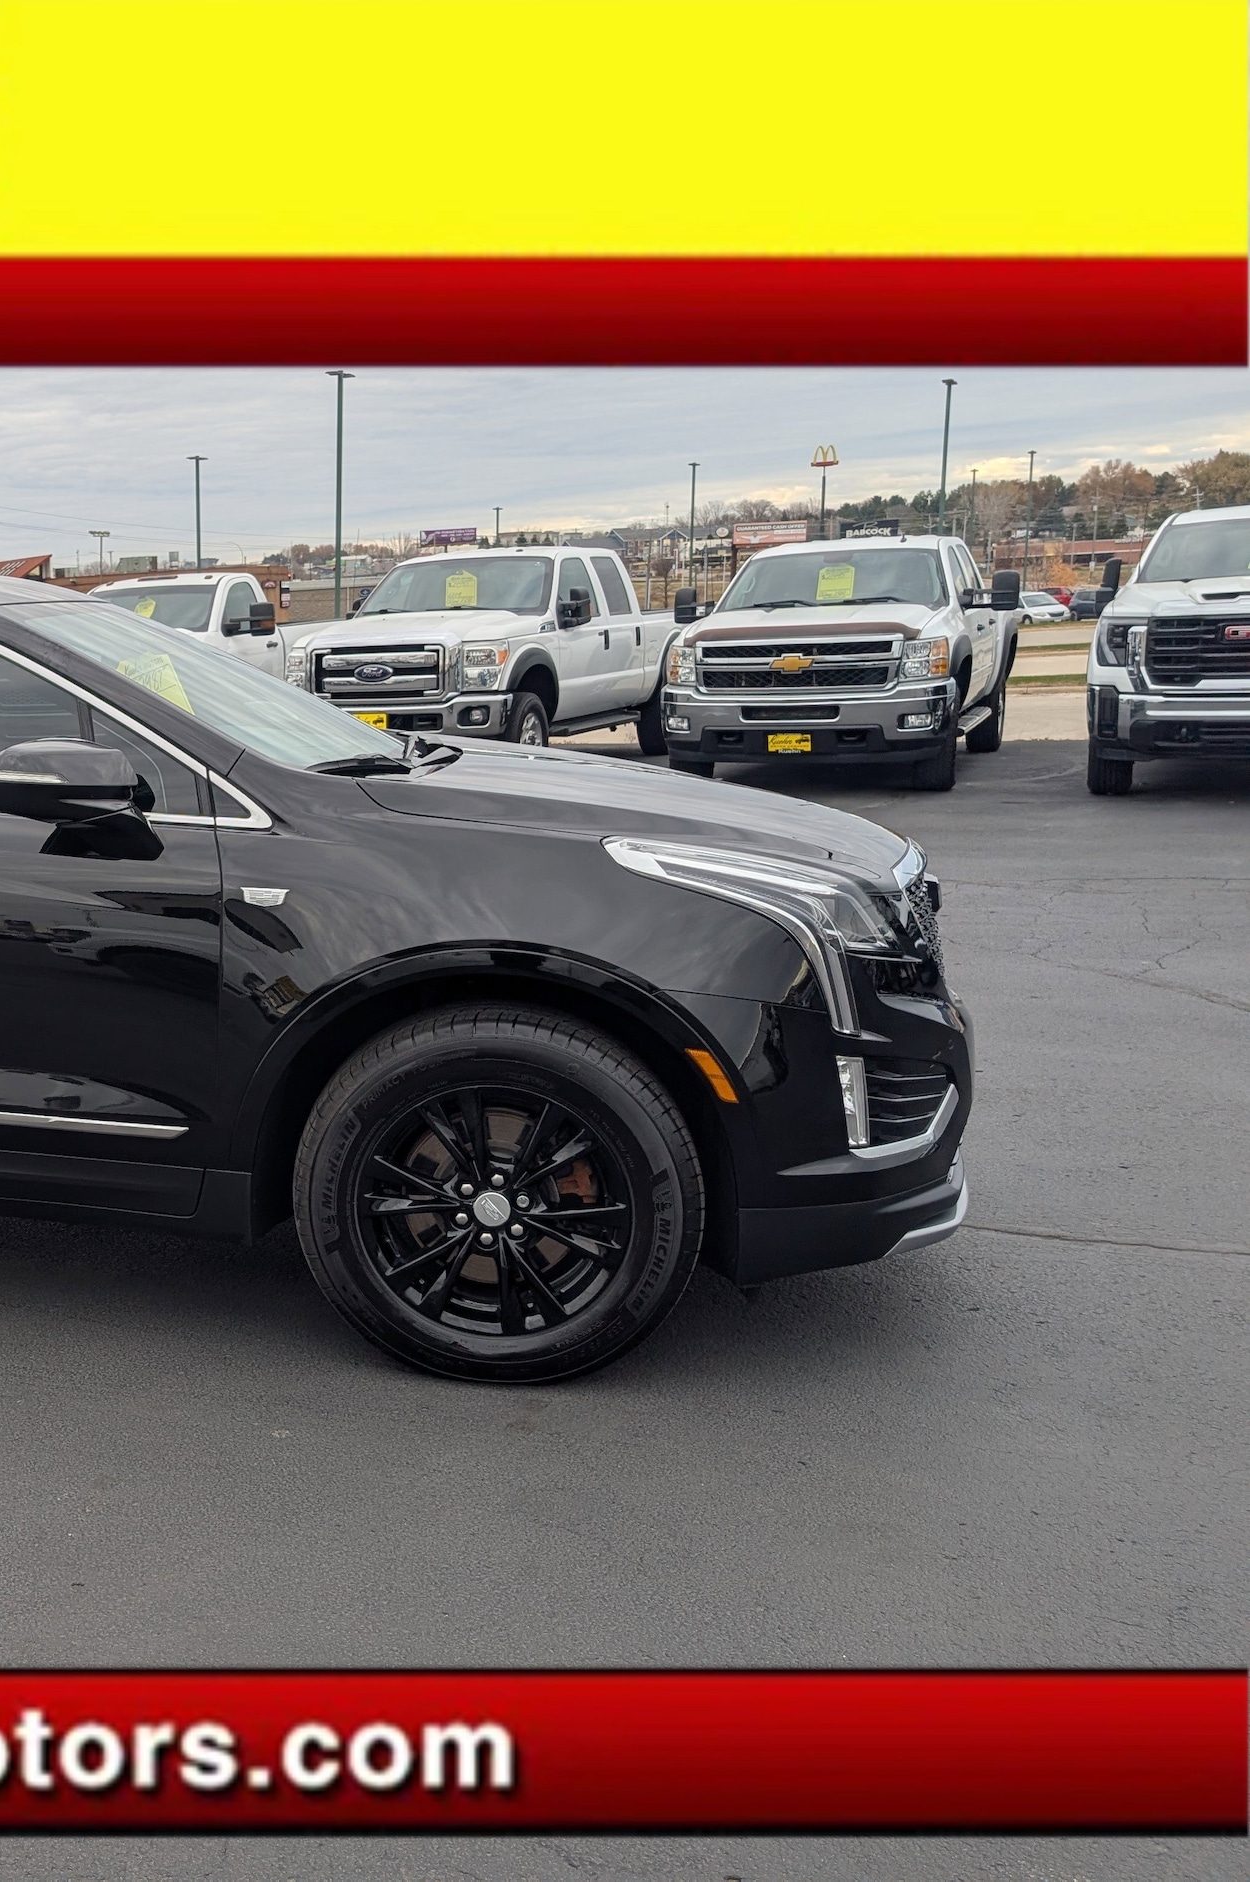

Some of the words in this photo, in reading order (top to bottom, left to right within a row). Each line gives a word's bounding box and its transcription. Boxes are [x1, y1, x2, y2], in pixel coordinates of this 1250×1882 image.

[845, 527, 892, 538] BABCOCK
[361, 1072, 406, 1111] PRIMACY
[320, 1119, 357, 1214] MICHELIN
[629, 1215, 673, 1315] MICHELIN
